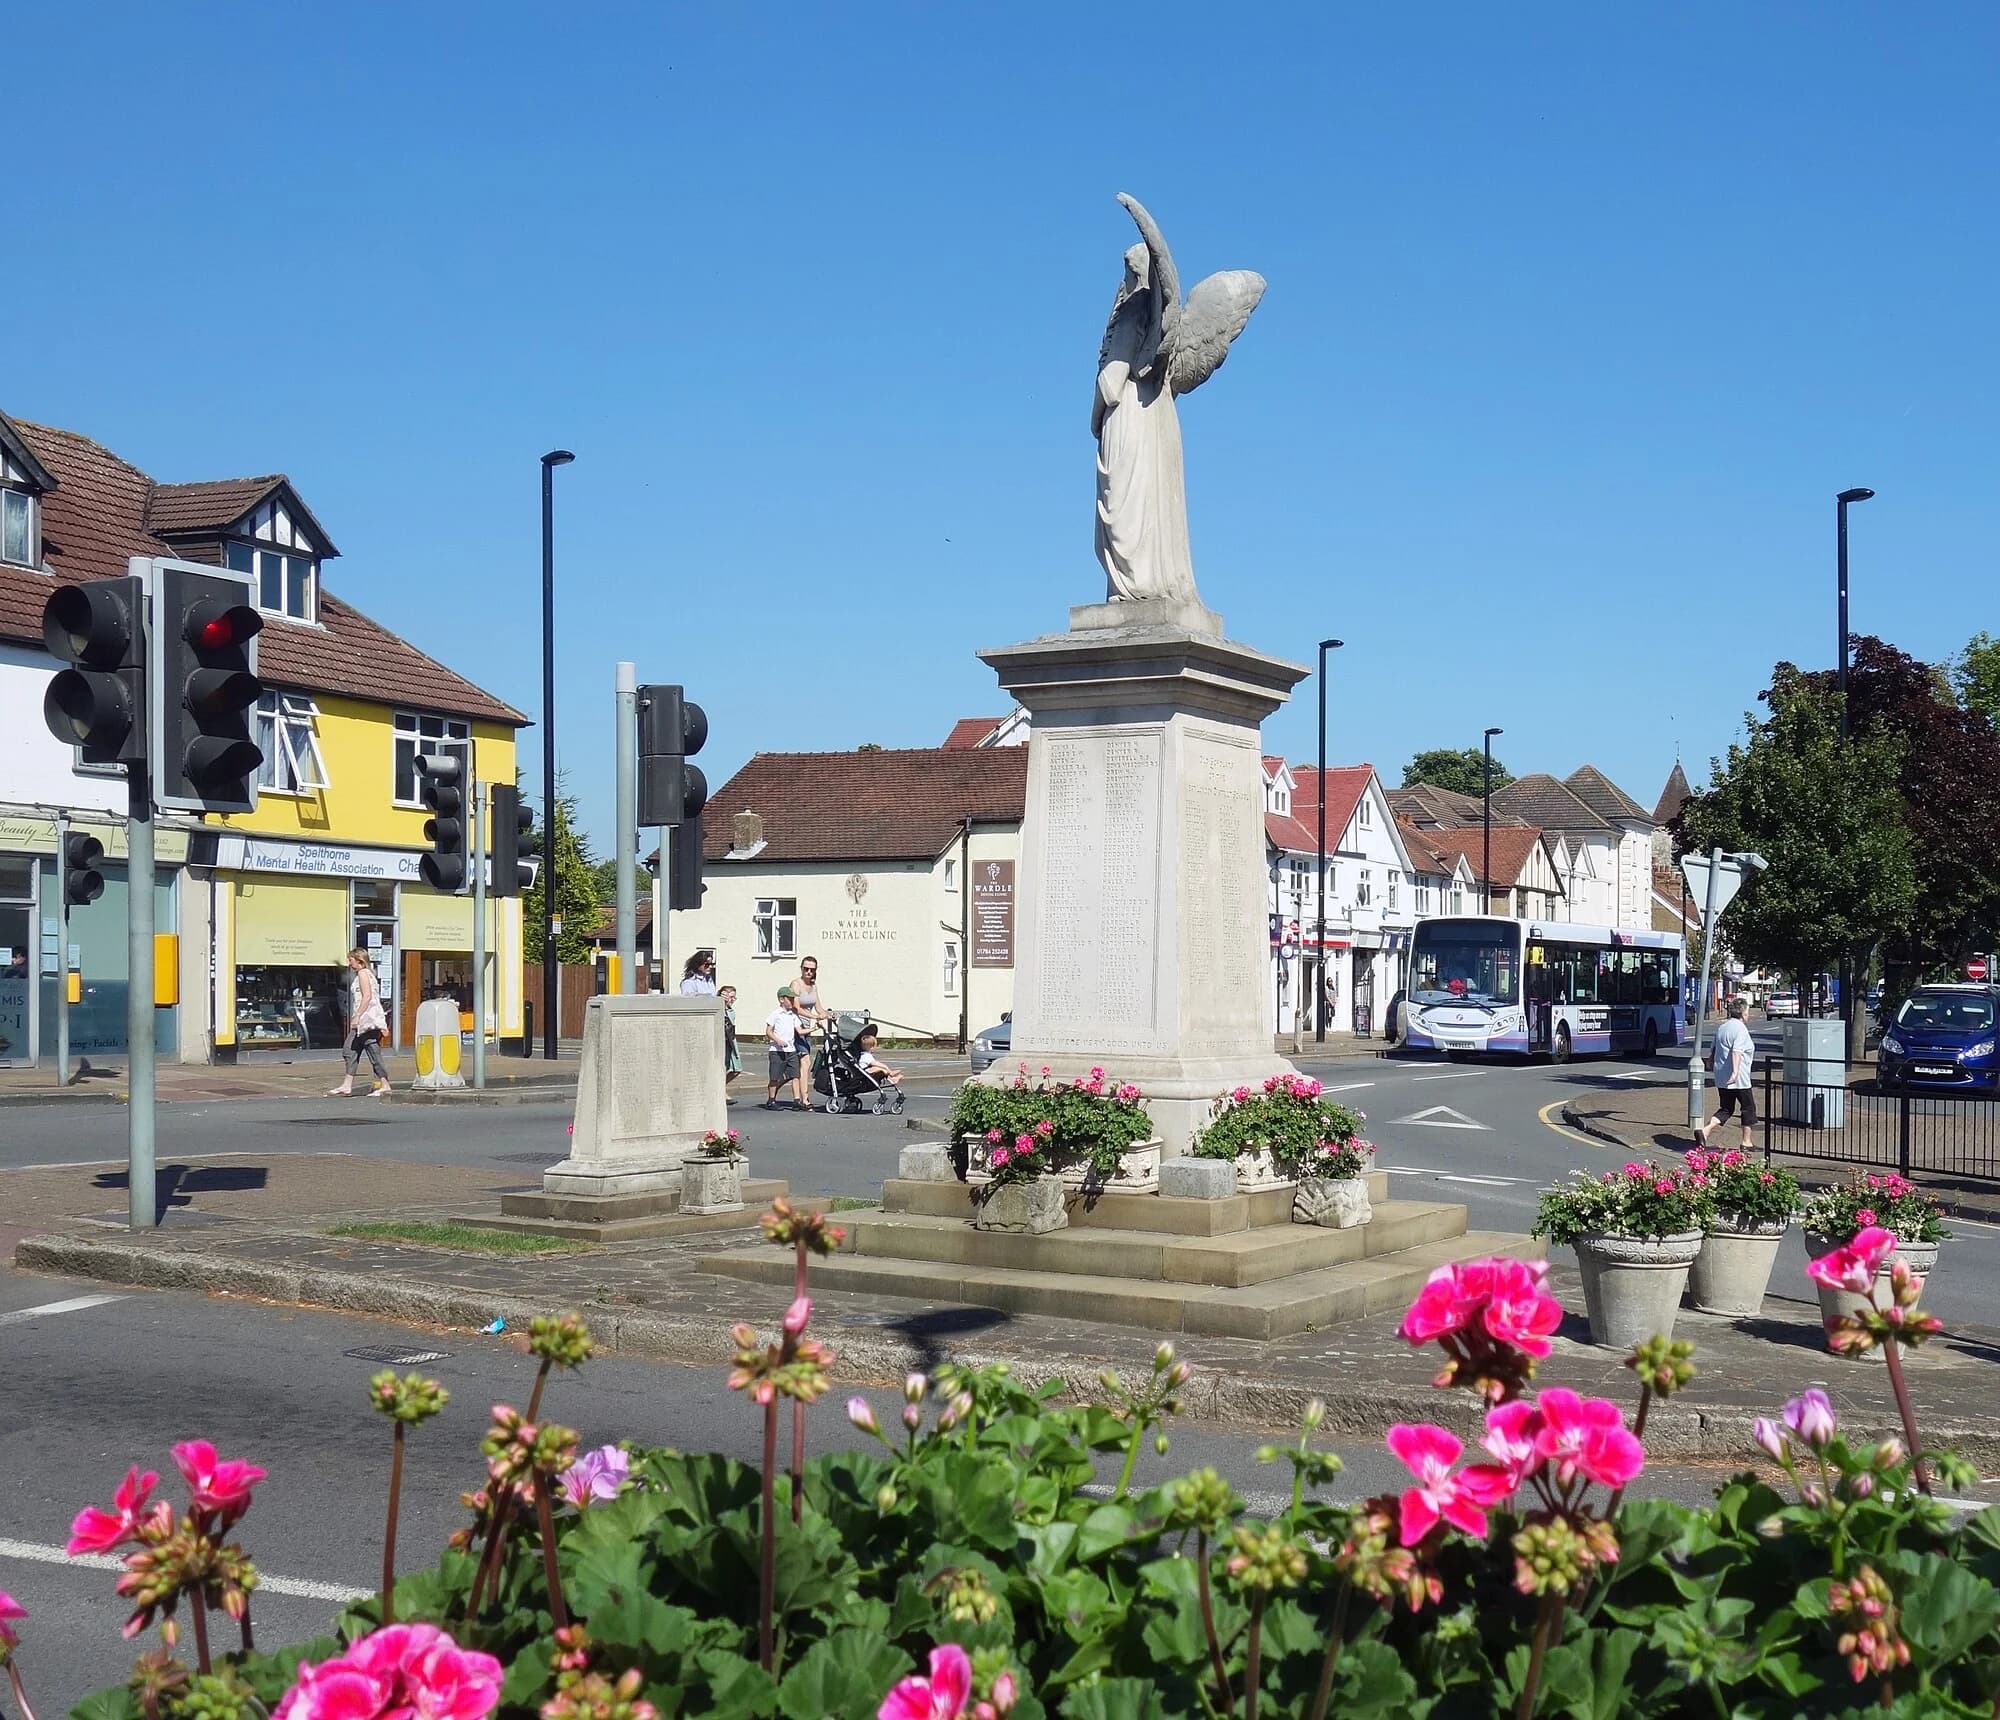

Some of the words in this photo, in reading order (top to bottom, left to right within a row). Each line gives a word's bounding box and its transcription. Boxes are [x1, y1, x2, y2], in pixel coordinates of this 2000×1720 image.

[298, 845, 351, 860] Spelthorne
[256, 855, 290, 869] Mental
[294, 858, 326, 872] Health
[329, 861, 385, 876] Association
[975, 884, 1012, 892] WARDLE
[850, 909, 868, 918] THE
[838, 919, 879, 928] WARDLE
[822, 930, 860, 940] DENTAL
[862, 930, 898, 940] CLINIC
